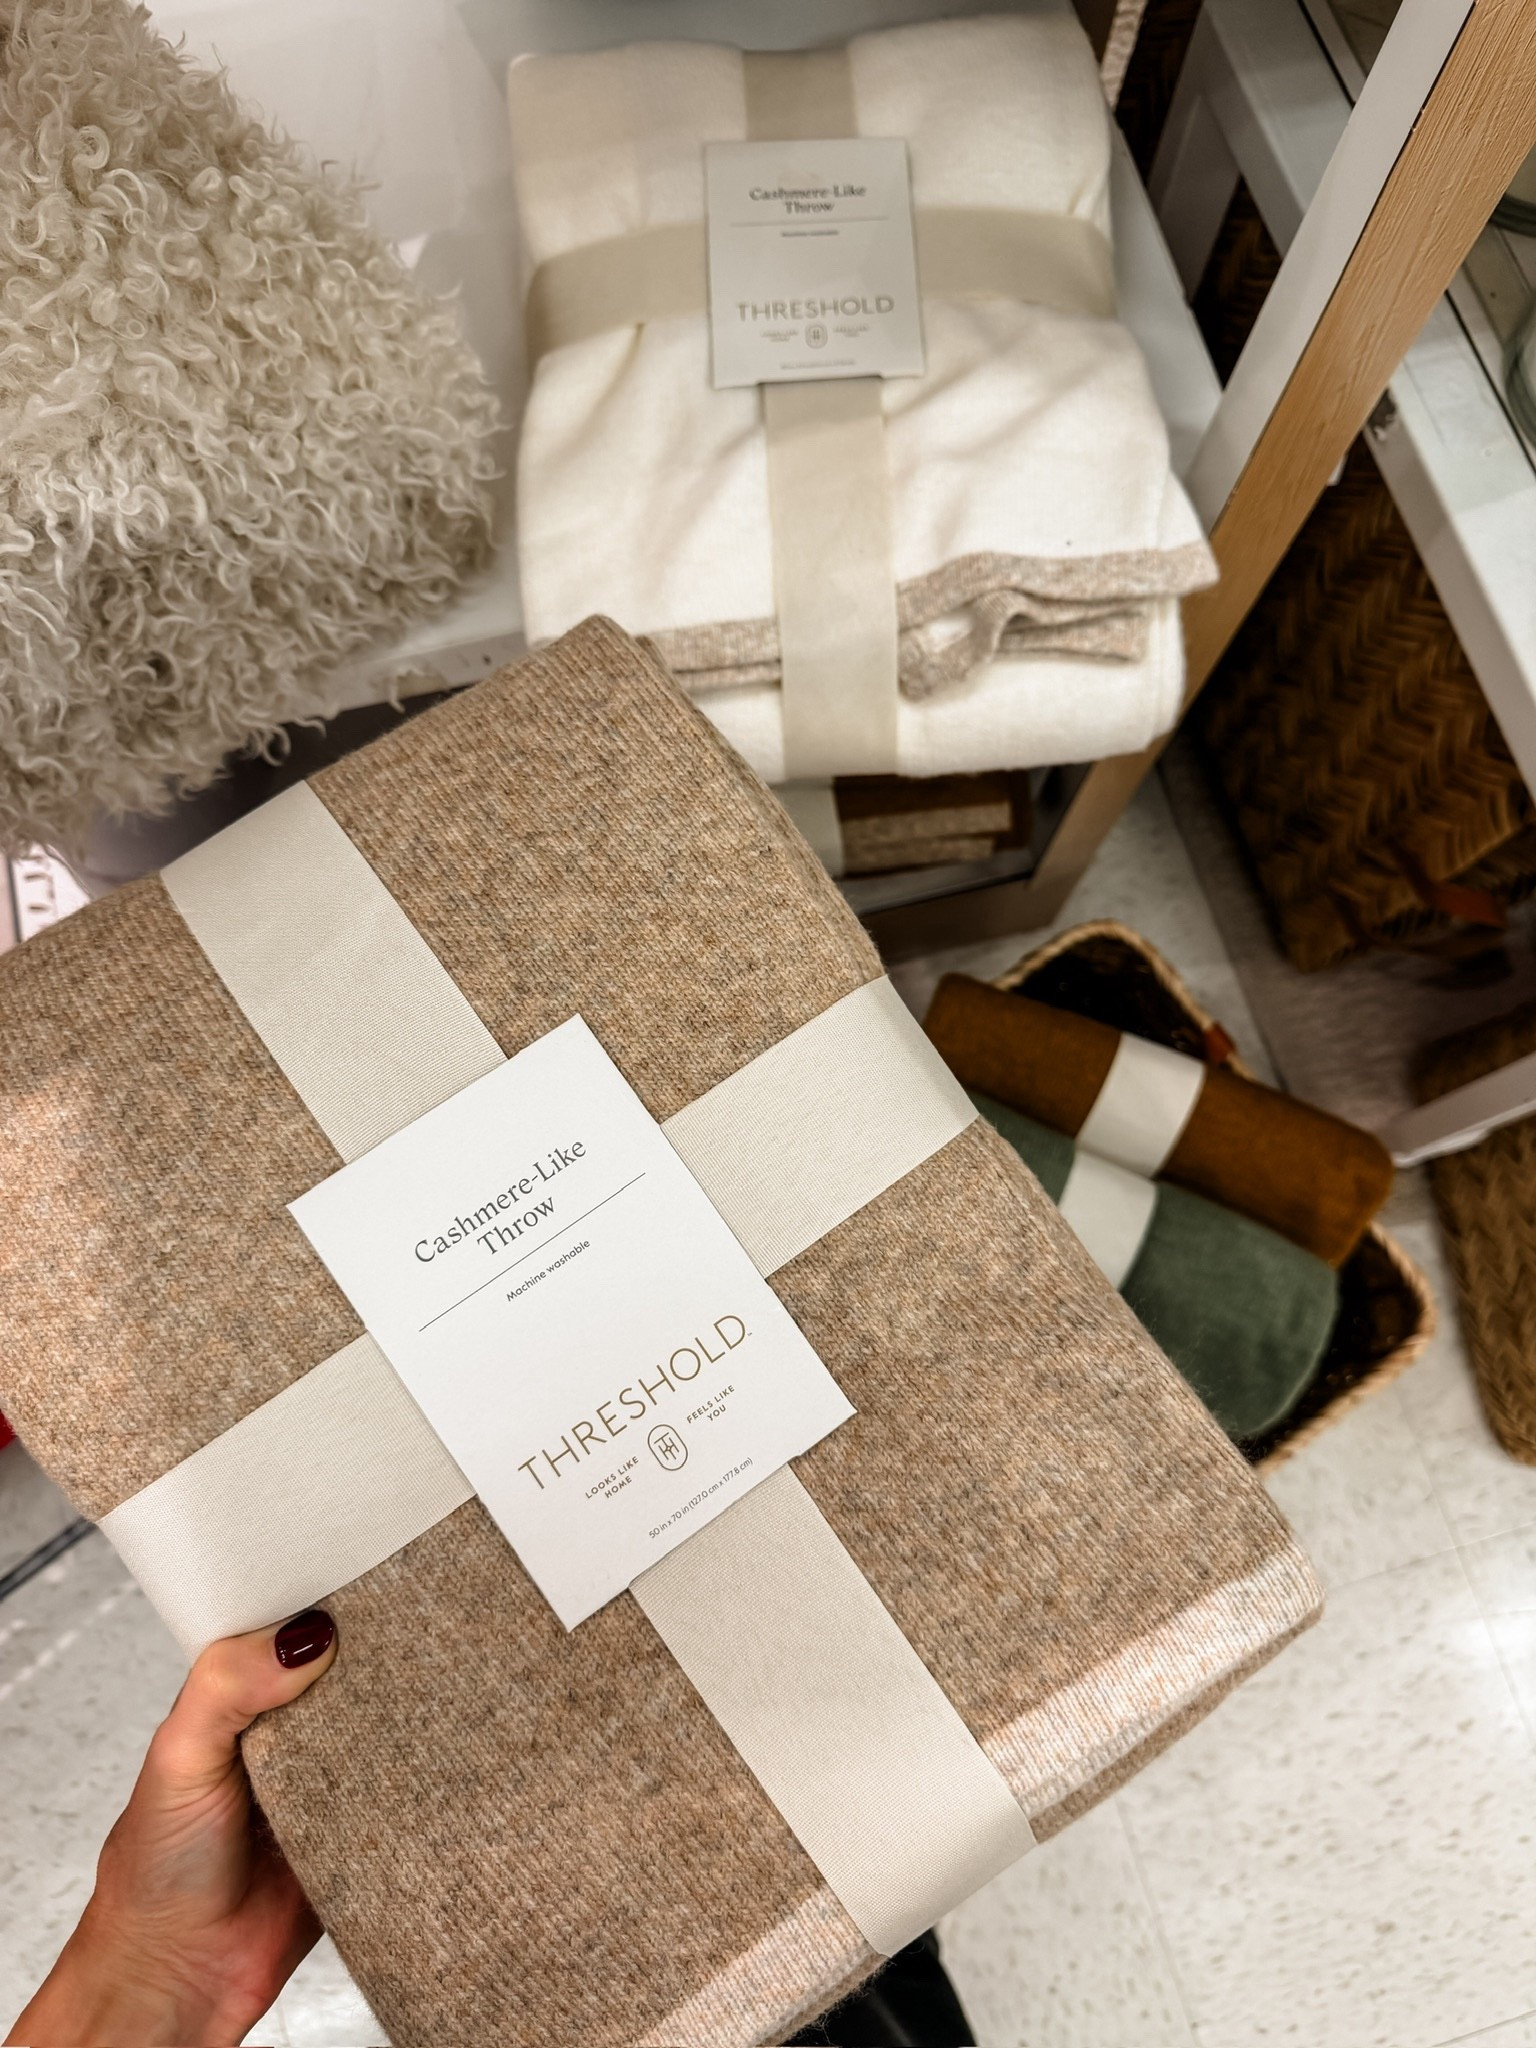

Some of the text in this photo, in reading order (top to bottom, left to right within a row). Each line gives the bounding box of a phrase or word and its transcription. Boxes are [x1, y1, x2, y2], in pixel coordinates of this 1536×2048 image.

[749, 185, 866, 200] Cashmere-Like
[784, 201, 834, 214] Throw
[738, 295, 895, 321] THRESHOLD
[414, 1141, 586, 1262] Cashmere-Like
[477, 1197, 555, 1255] Throw
[506, 1239, 591, 1302] Machine washable
[517, 1315, 746, 1490] THRESHOLD
[686, 1384, 736, 1424] FEELS LIKE
[706, 1404, 727, 1422] YOU
[585, 1456, 639, 1499] LOOKS LIKE
[604, 1475, 633, 1499] HOME
[648, 1527, 661, 1539] 50
[660, 1522, 668, 1531] in
[671, 1511, 682, 1522] 70
[682, 1505, 690, 1515] in
[688, 1490, 709, 1509] (127.0
[708, 1483, 719, 1494] cm
[722, 1466, 740, 1482] 177.8
[739, 1457, 753, 1470] cm)
